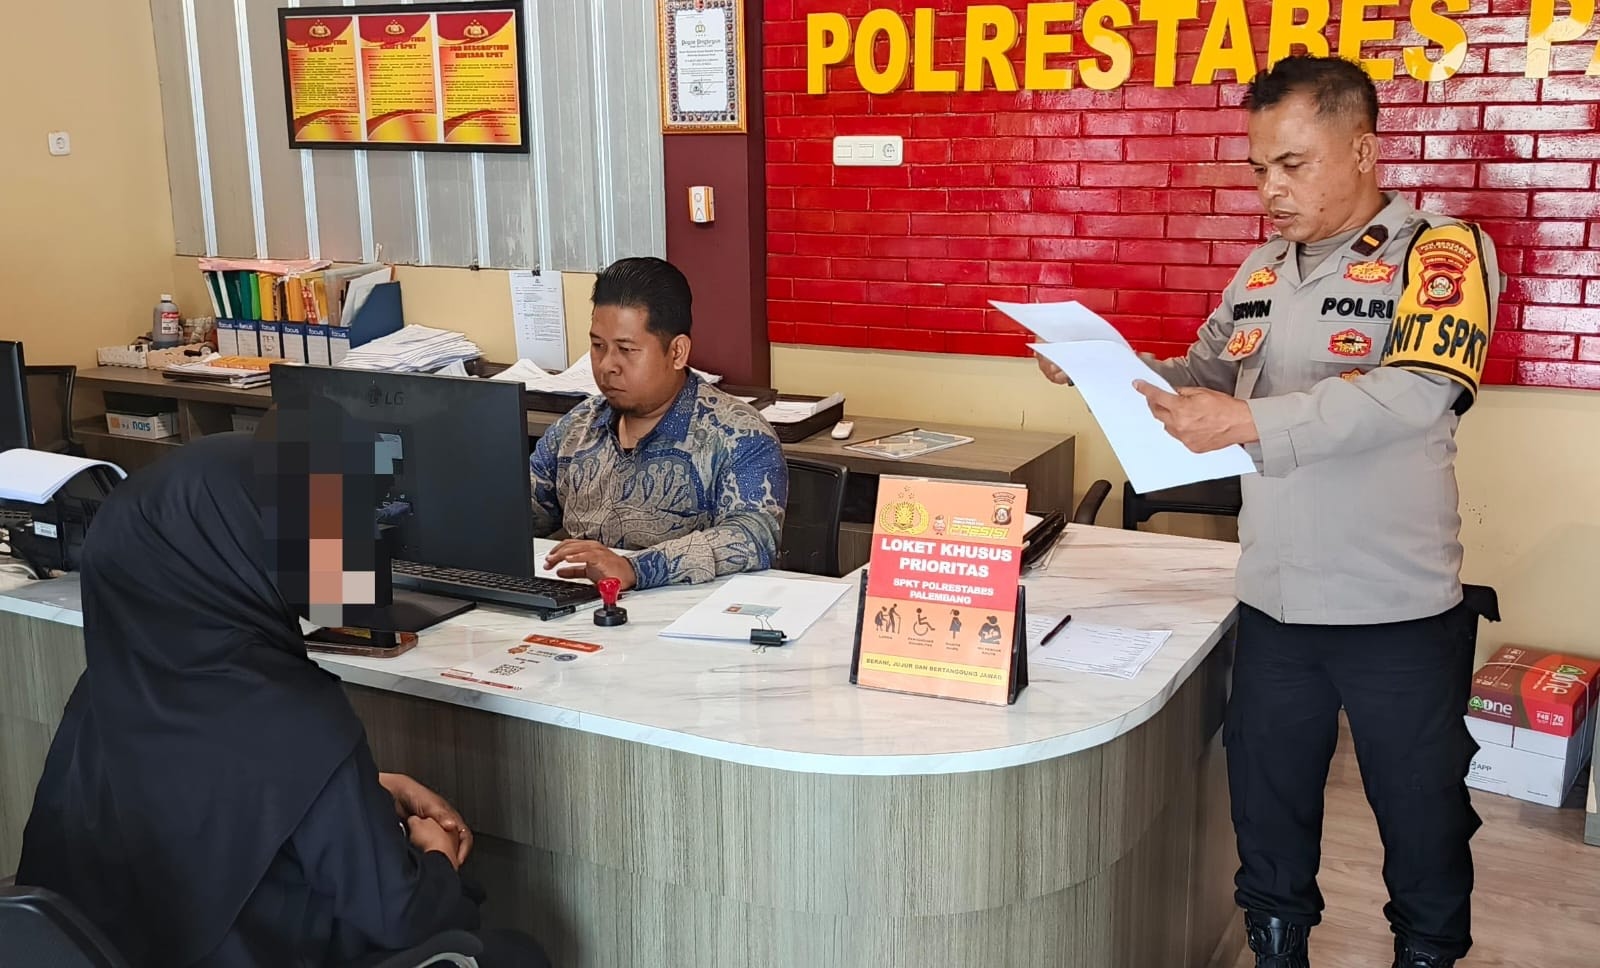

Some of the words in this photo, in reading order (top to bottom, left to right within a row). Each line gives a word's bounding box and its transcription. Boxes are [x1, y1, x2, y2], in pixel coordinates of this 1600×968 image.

[807, 0, 1469, 95] POLRESTABES
[1525, 0, 1600, 79] P
[1320, 297, 1393, 319] POLRI
[284, 325, 300, 334] focus
[385, 391, 404, 406] LG
[881, 537, 936, 555] LOKET
[940, 544, 1013, 562] KHUSUS
[899, 557, 989, 578] PRIORITAS
[893, 578, 919, 589] SPKT
[922, 581, 995, 597] POLRESTABES
[910, 591, 972, 605] PALEMBANG
[1477, 763, 1492, 771] APP
